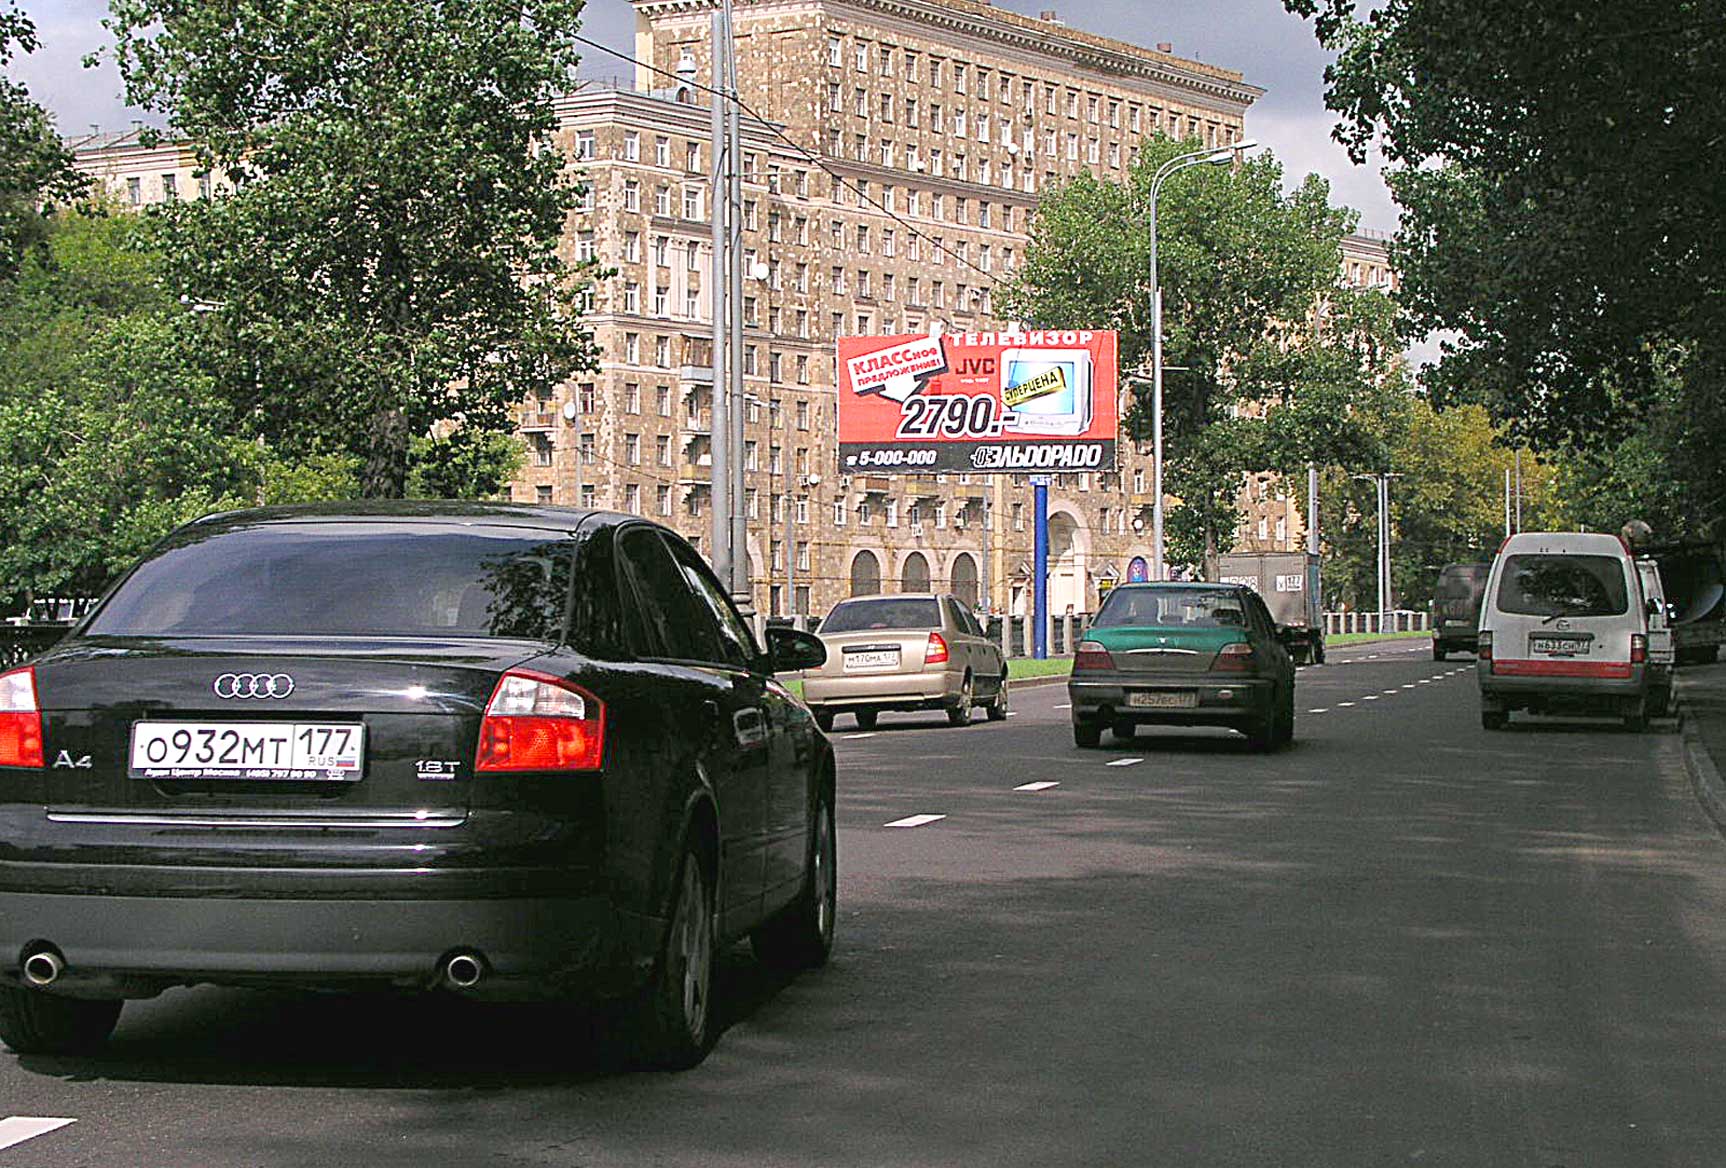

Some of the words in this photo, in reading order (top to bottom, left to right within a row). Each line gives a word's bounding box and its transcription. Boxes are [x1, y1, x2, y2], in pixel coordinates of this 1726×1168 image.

[951, 331, 1093, 347] ТЕЛЕВИЗОР
[955, 358, 995, 375] JVC
[1004, 371, 1059, 401] СУПЕРЦЕНА
[858, 449, 937, 465] 5-000-000
[146, 729, 288, 764] О932МТ
[298, 728, 352, 755] 177
[52, 749, 93, 768] A4
[307, 756, 335, 766] RUS
